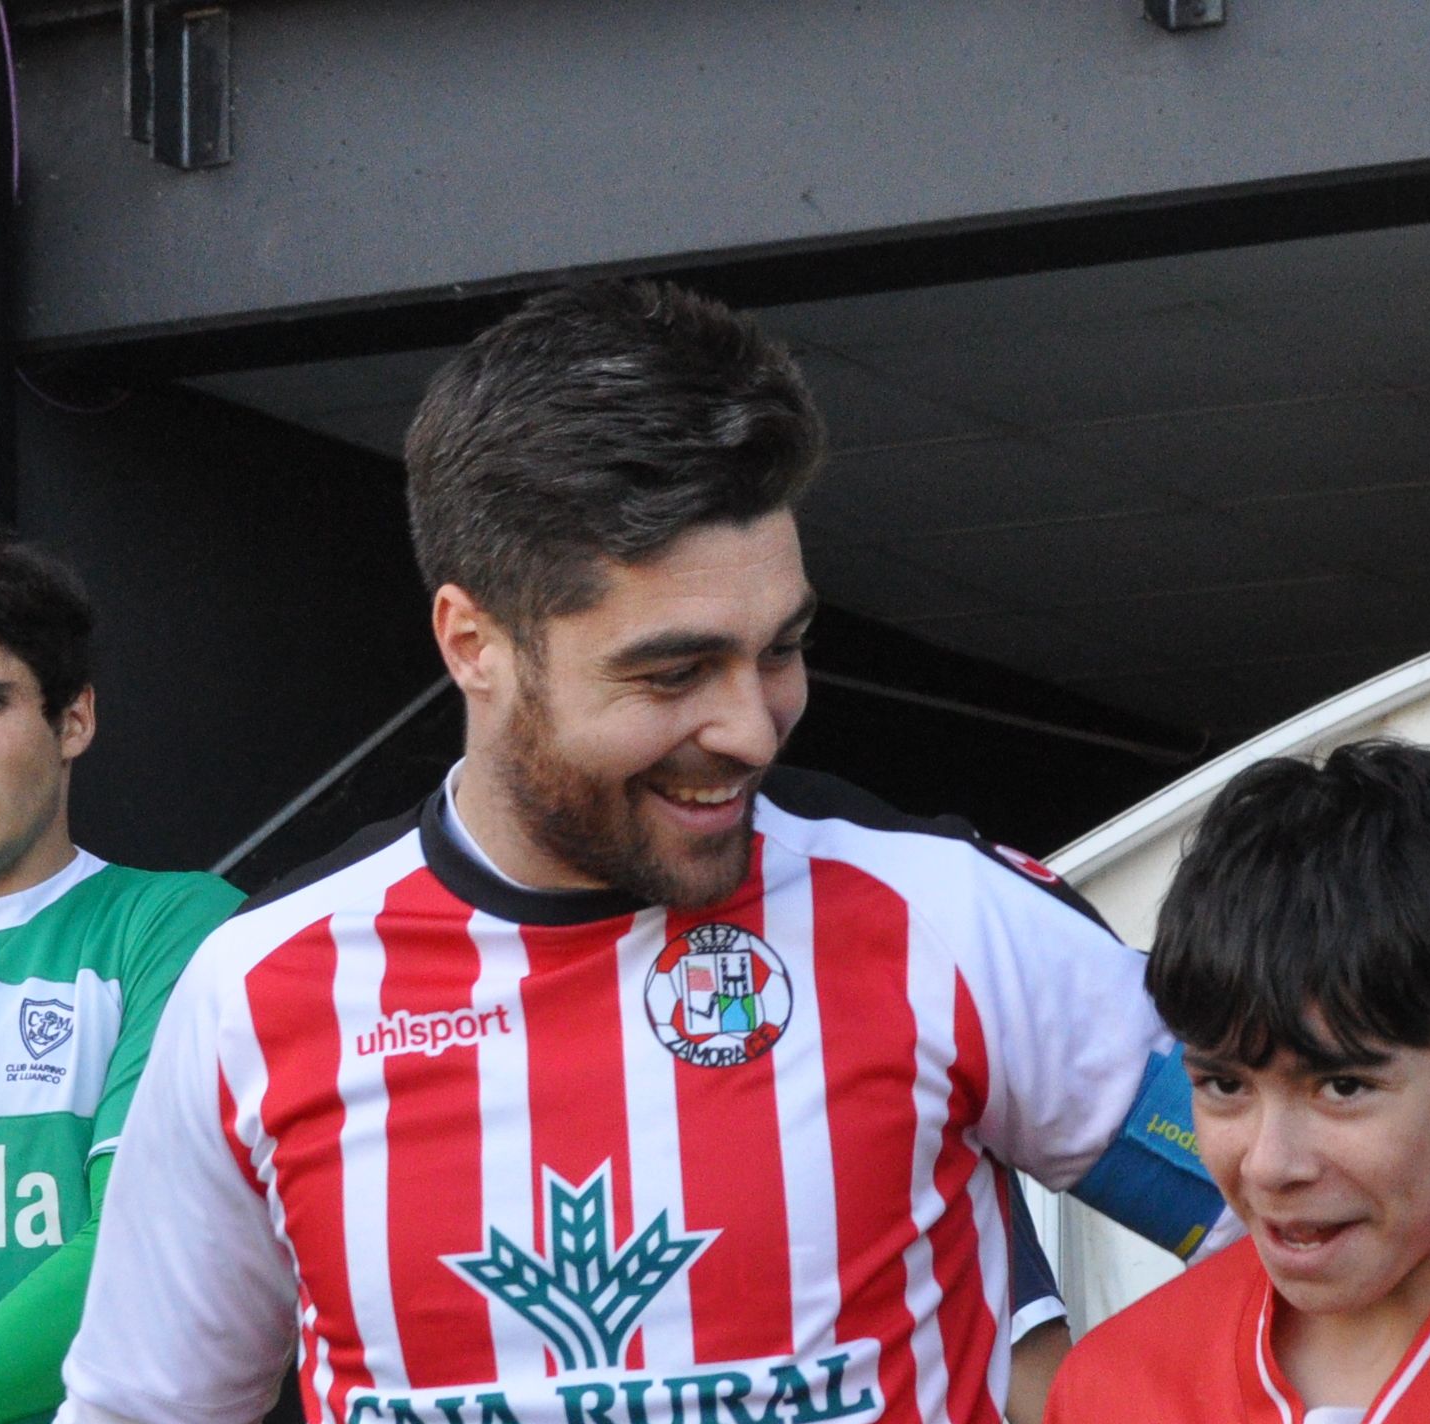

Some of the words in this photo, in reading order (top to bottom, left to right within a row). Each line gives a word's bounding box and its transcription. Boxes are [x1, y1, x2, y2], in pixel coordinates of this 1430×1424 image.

[357, 1005, 511, 1056] uhlsport
[665, 1036, 748, 1068] ZAMORA
[5, 1063, 27, 1073] CLUB
[30, 1064, 67, 1076] MARINO
[6, 1073, 17, 1082] DE
[20, 1073, 61, 1085] LUANCO
